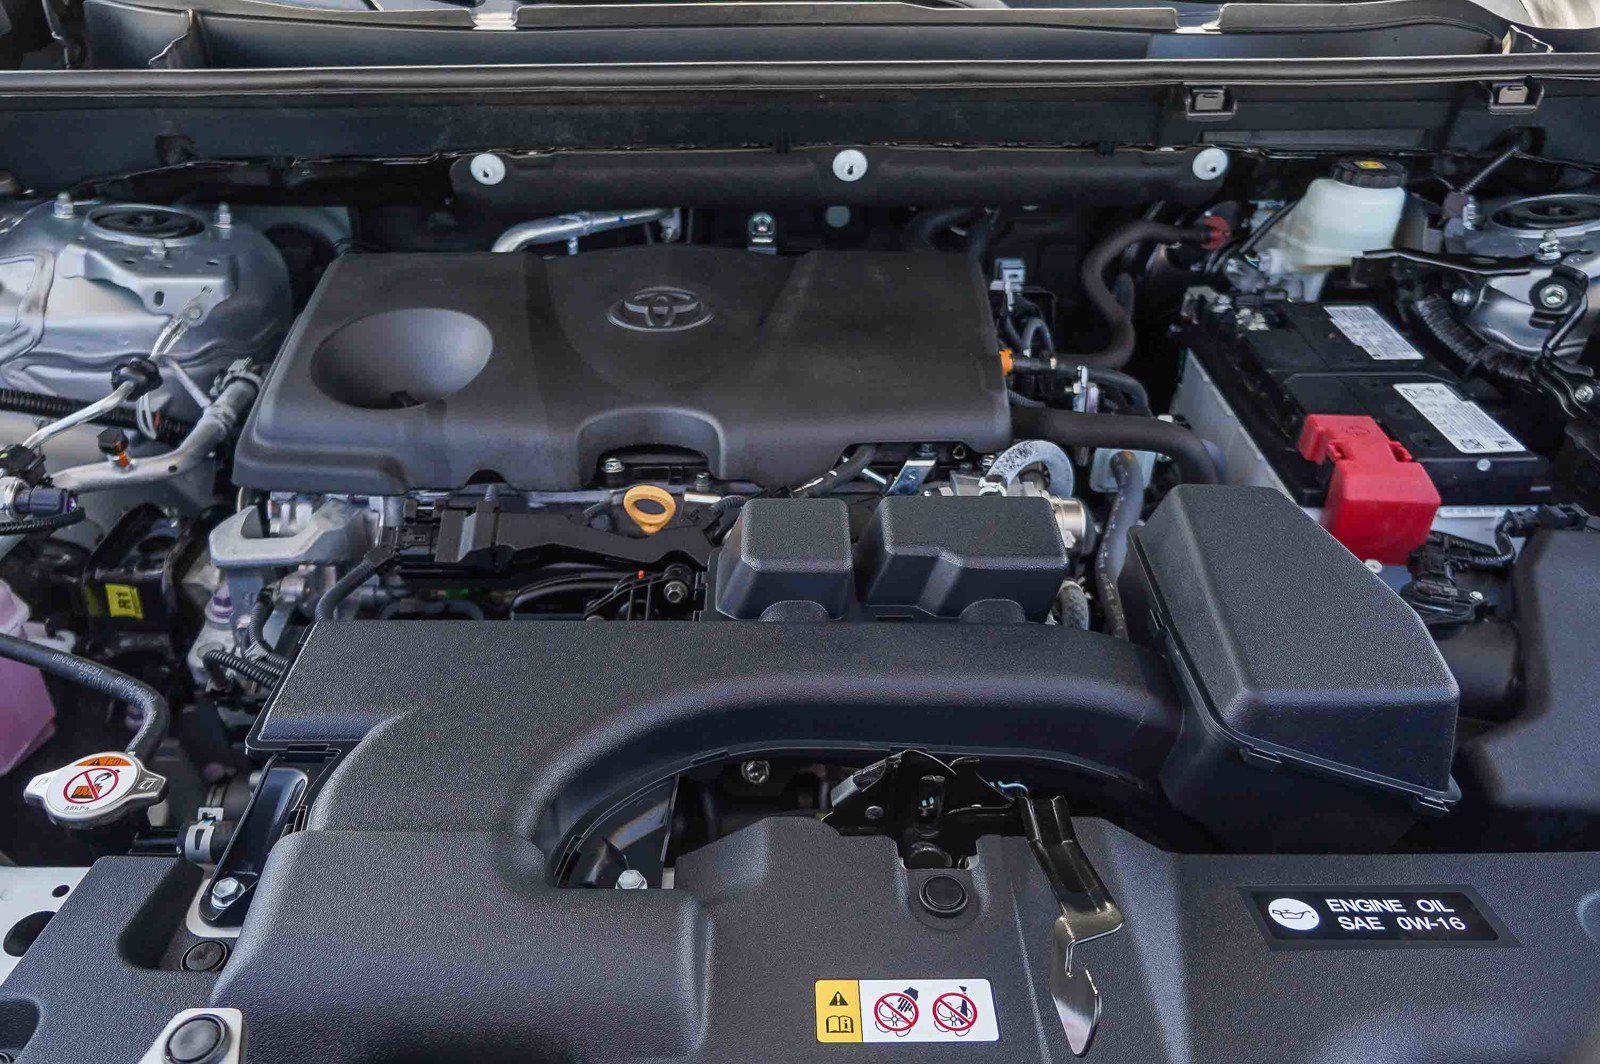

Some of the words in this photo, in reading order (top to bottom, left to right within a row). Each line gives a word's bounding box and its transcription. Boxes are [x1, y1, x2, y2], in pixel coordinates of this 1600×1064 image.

[1325, 899, 1406, 913] ENGINE
[1416, 899, 1455, 913] OIL
[1338, 917, 1385, 930] SAE
[1397, 917, 1466, 931] 0W-16
